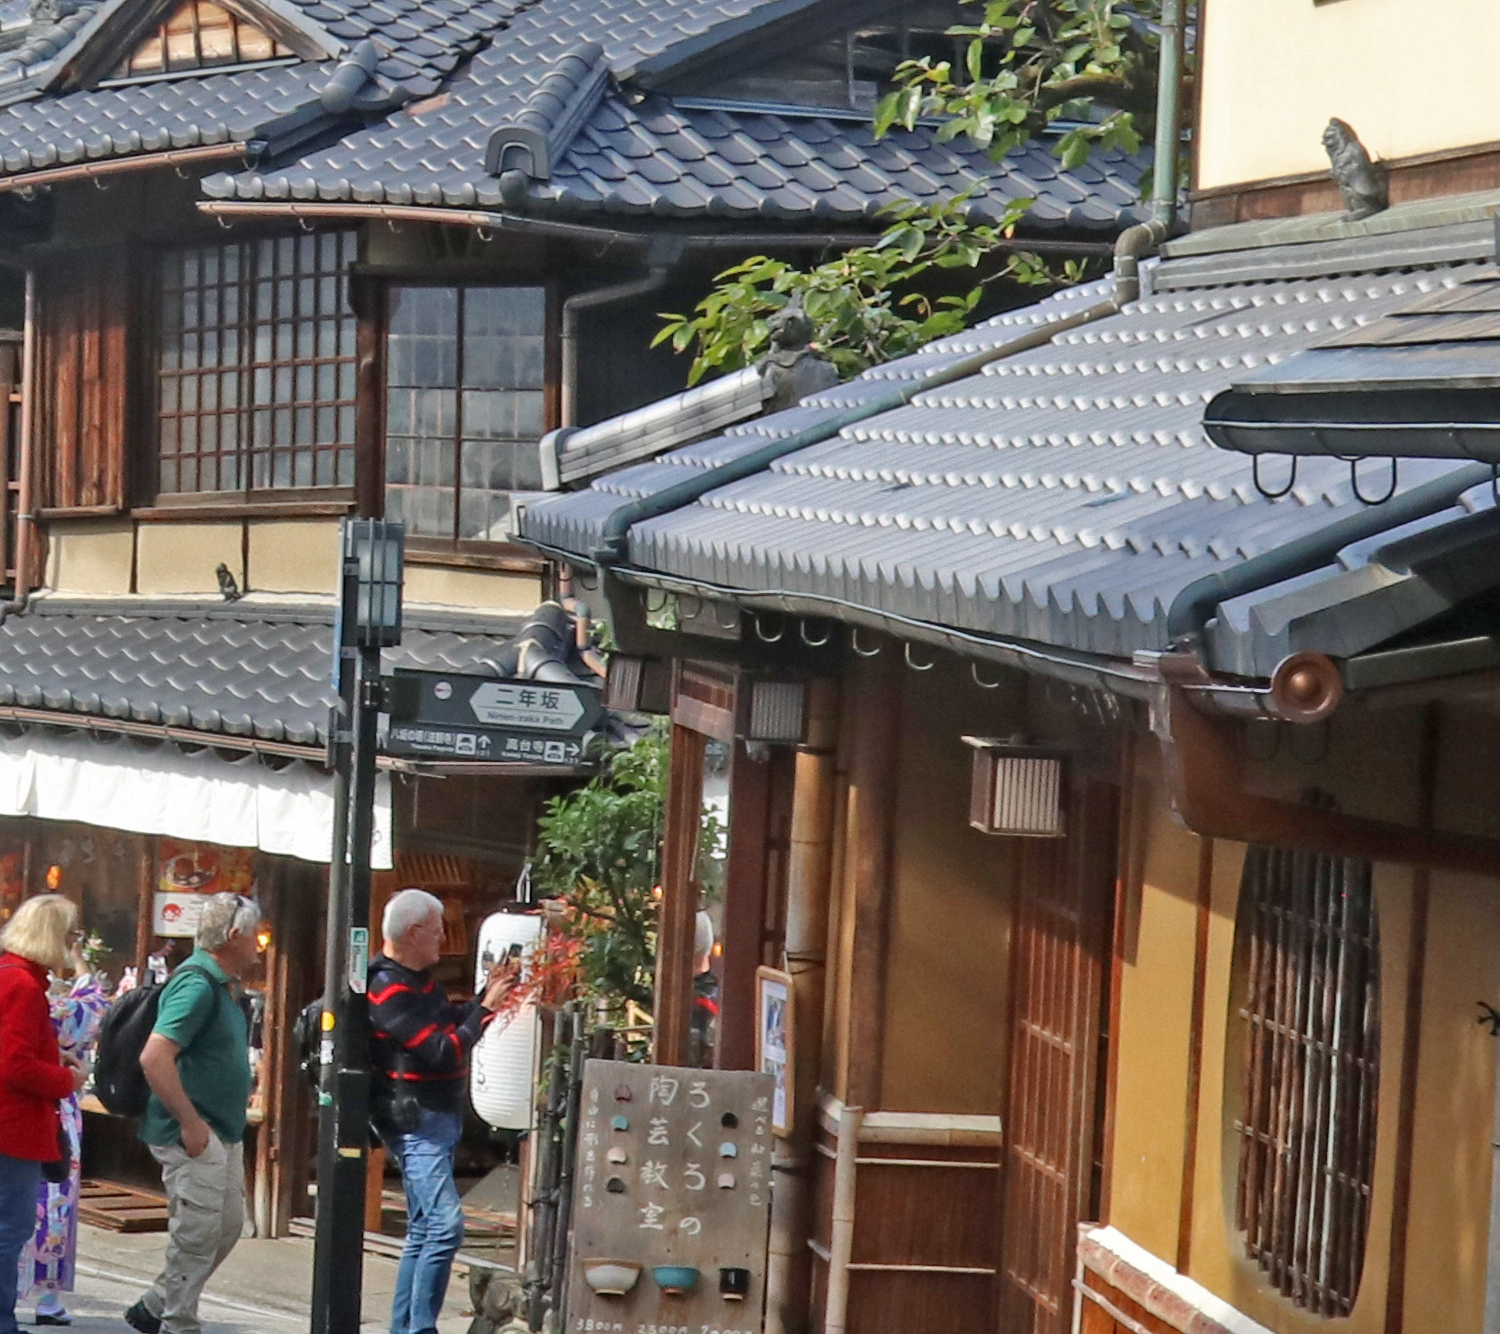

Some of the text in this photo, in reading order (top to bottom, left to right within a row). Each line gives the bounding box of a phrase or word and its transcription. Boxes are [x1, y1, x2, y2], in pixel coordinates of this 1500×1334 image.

[495, 688, 561, 710] 二年坂
[505, 738, 544, 753] 高台寺
[639, 1075, 679, 1232] 陶芸教室
[679, 1080, 712, 1236] ろくろの
